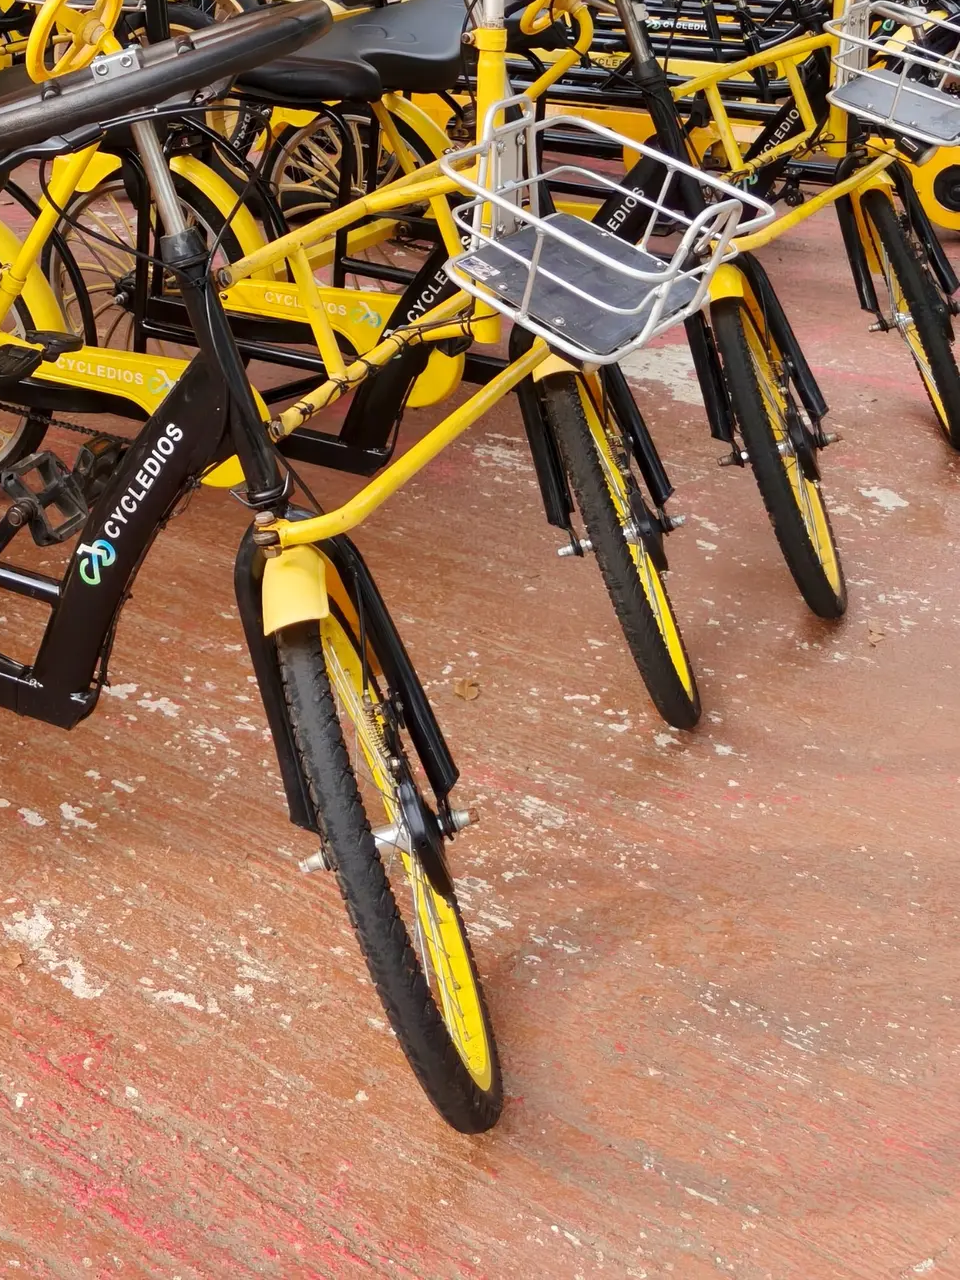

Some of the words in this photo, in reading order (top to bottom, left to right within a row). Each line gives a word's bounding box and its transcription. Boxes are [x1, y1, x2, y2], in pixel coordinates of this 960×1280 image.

[604, 186, 645, 234] EDIOS
[56, 357, 144, 385] CYCLEDIOS
[104, 423, 183, 539] CYCLEDIOS
